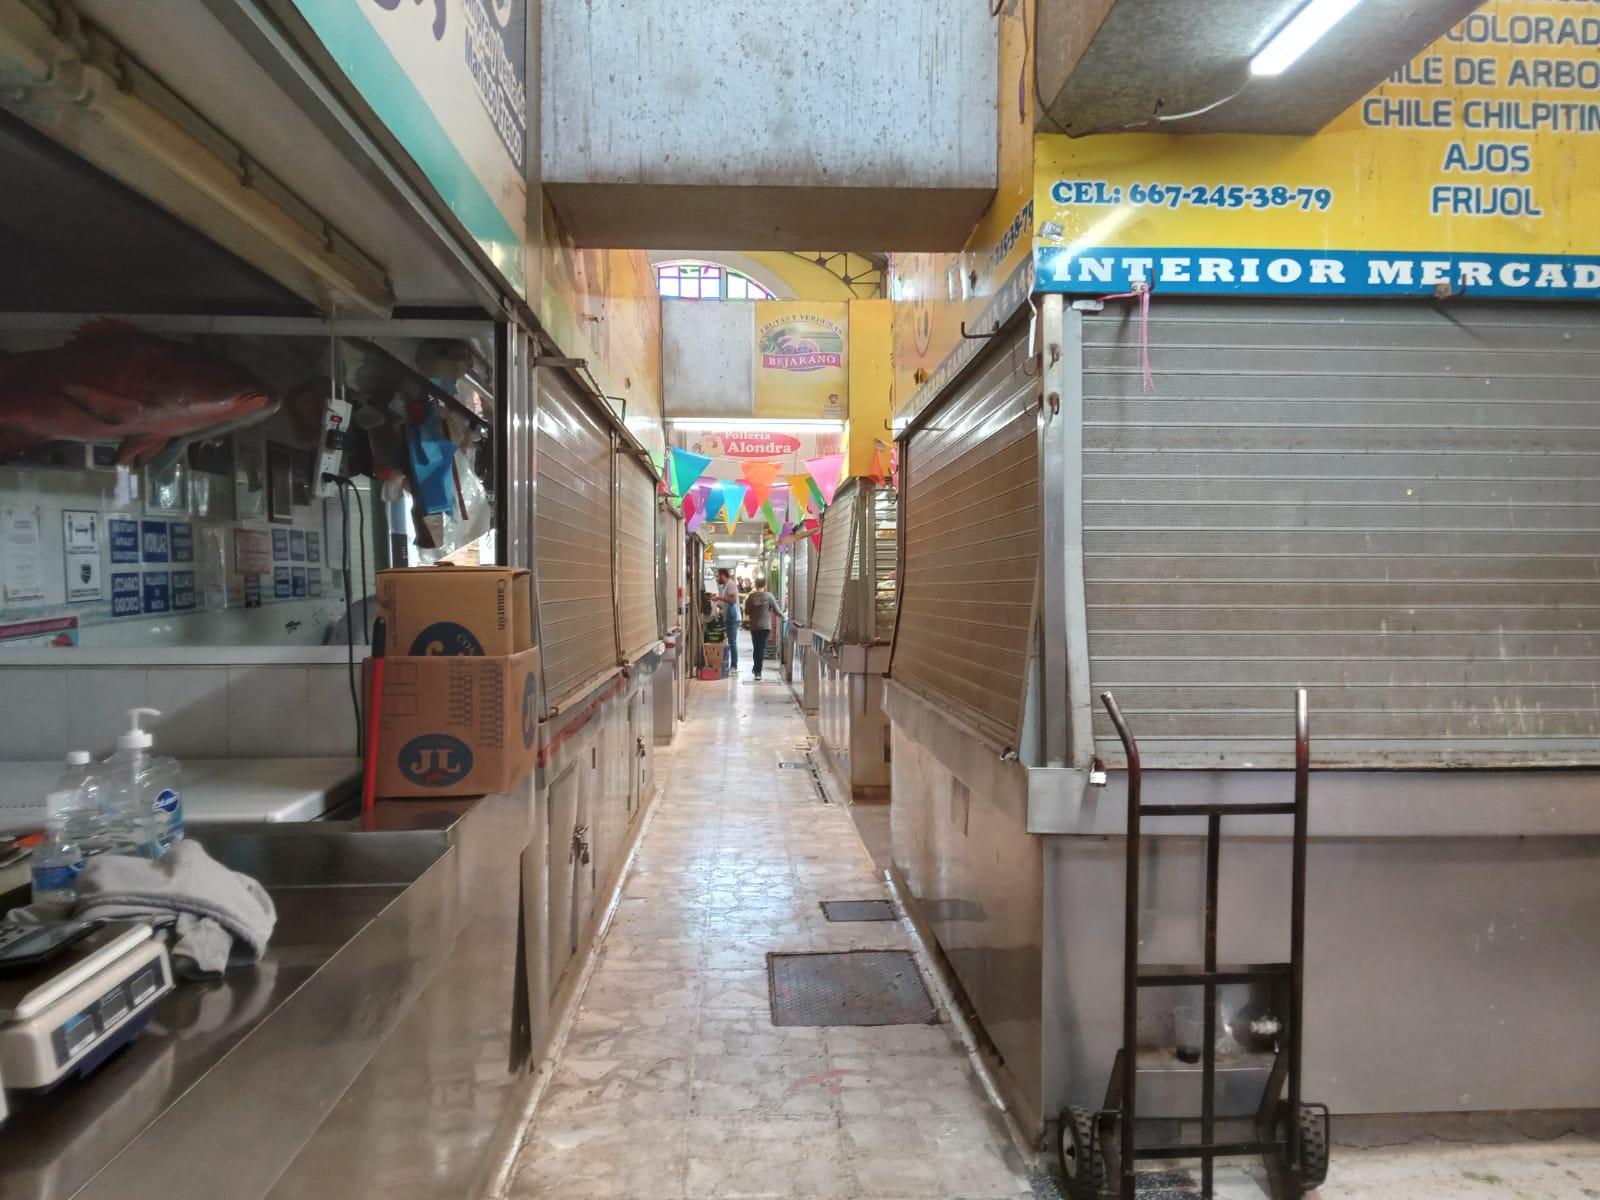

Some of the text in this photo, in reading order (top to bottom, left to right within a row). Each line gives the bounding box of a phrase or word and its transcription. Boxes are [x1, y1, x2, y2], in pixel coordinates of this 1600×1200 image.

[1455, 58, 1496, 85] DE
[1508, 60, 1600, 88] ARBO
[1363, 98, 1452, 127] CHILE
[1444, 144, 1530, 172] AJOS
[1051, 182, 1332, 210] CEL: 667-245-38-79
[1432, 186, 1541, 215] FRIJOL
[1052, 257, 1346, 283] INTERIOR
[1367, 260, 1600, 289] MERCAD
[799, 314, 842, 335] VERDURAS
[769, 355, 836, 368] BEJARANO
[728, 442, 792, 454] Alondra
